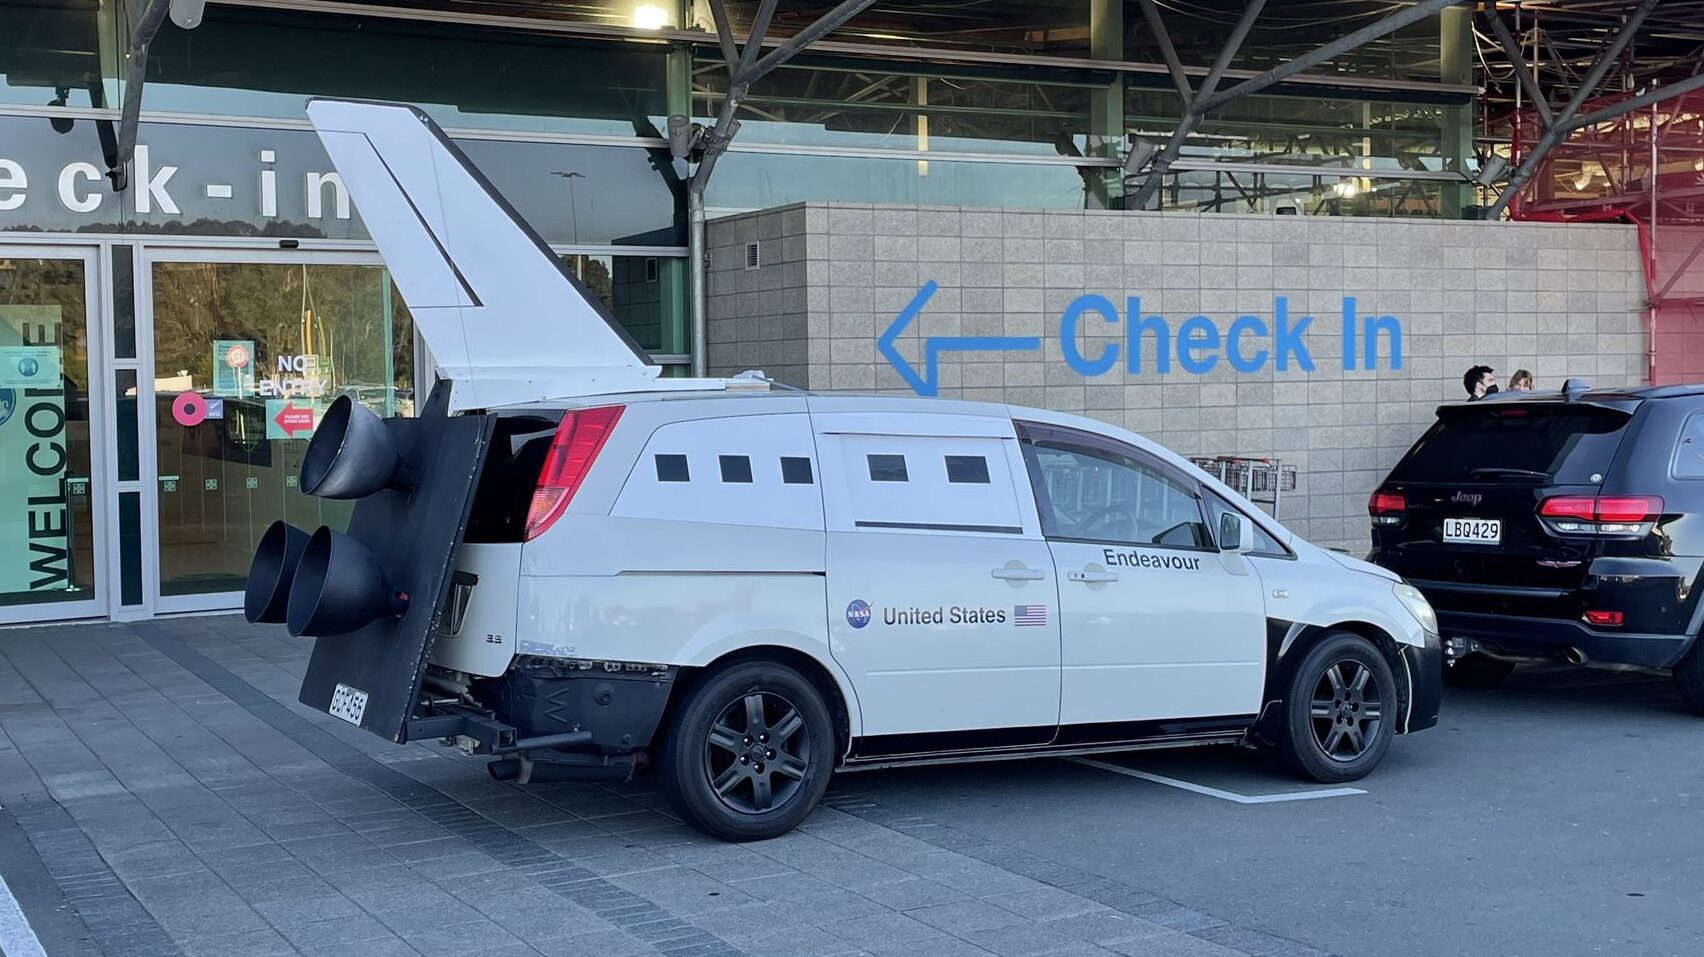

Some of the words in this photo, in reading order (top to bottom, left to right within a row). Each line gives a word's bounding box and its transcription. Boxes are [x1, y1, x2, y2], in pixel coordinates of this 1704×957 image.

[1060, 294, 1315, 376] Check
[1342, 296, 1402, 370] In
[278, 355, 308, 372] NO
[259, 379, 327, 396] ENTRY
[1450, 491, 1482, 506] Jeep
[1445, 521, 1499, 539] LBQ429
[1103, 548, 1201, 572] Endeavour
[847, 610, 870, 618] NASA
[883, 607, 944, 626] United
[949, 606, 1007, 625] States
